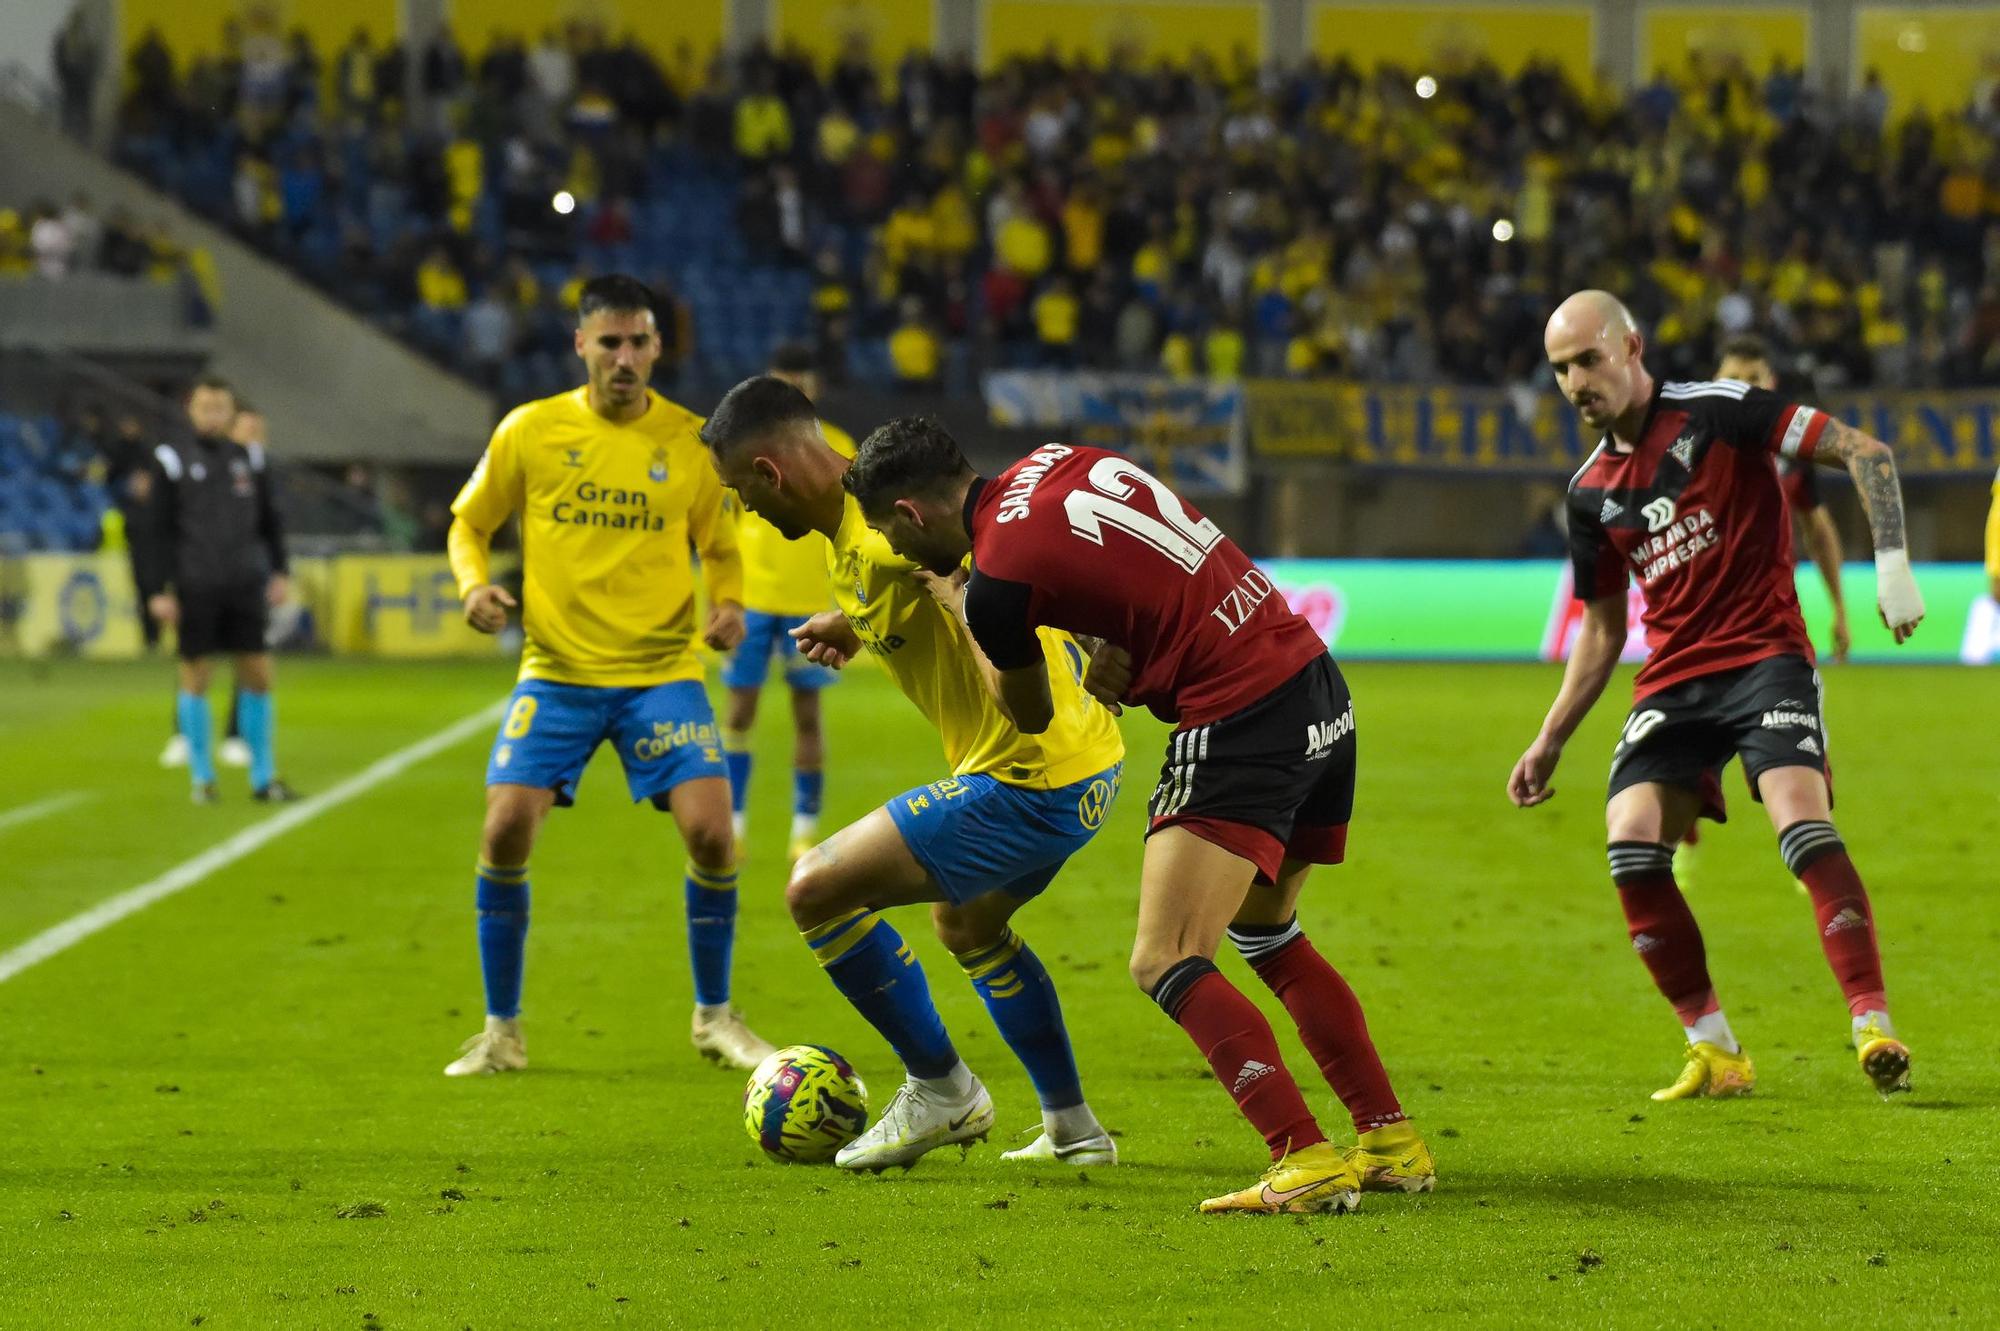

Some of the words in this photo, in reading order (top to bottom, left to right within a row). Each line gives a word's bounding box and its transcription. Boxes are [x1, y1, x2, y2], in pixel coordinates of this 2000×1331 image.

[577, 482, 648, 507] Gran
[996, 443, 1073, 523] SALINAS
[553, 502, 664, 531] Canaria
[1063, 457, 1225, 575] 12
[1630, 508, 1715, 565] MIRANDA
[1643, 527, 1719, 585] EMPRESAS
[504, 695, 538, 739] 8
[1233, 1065, 1276, 1093] adidas
